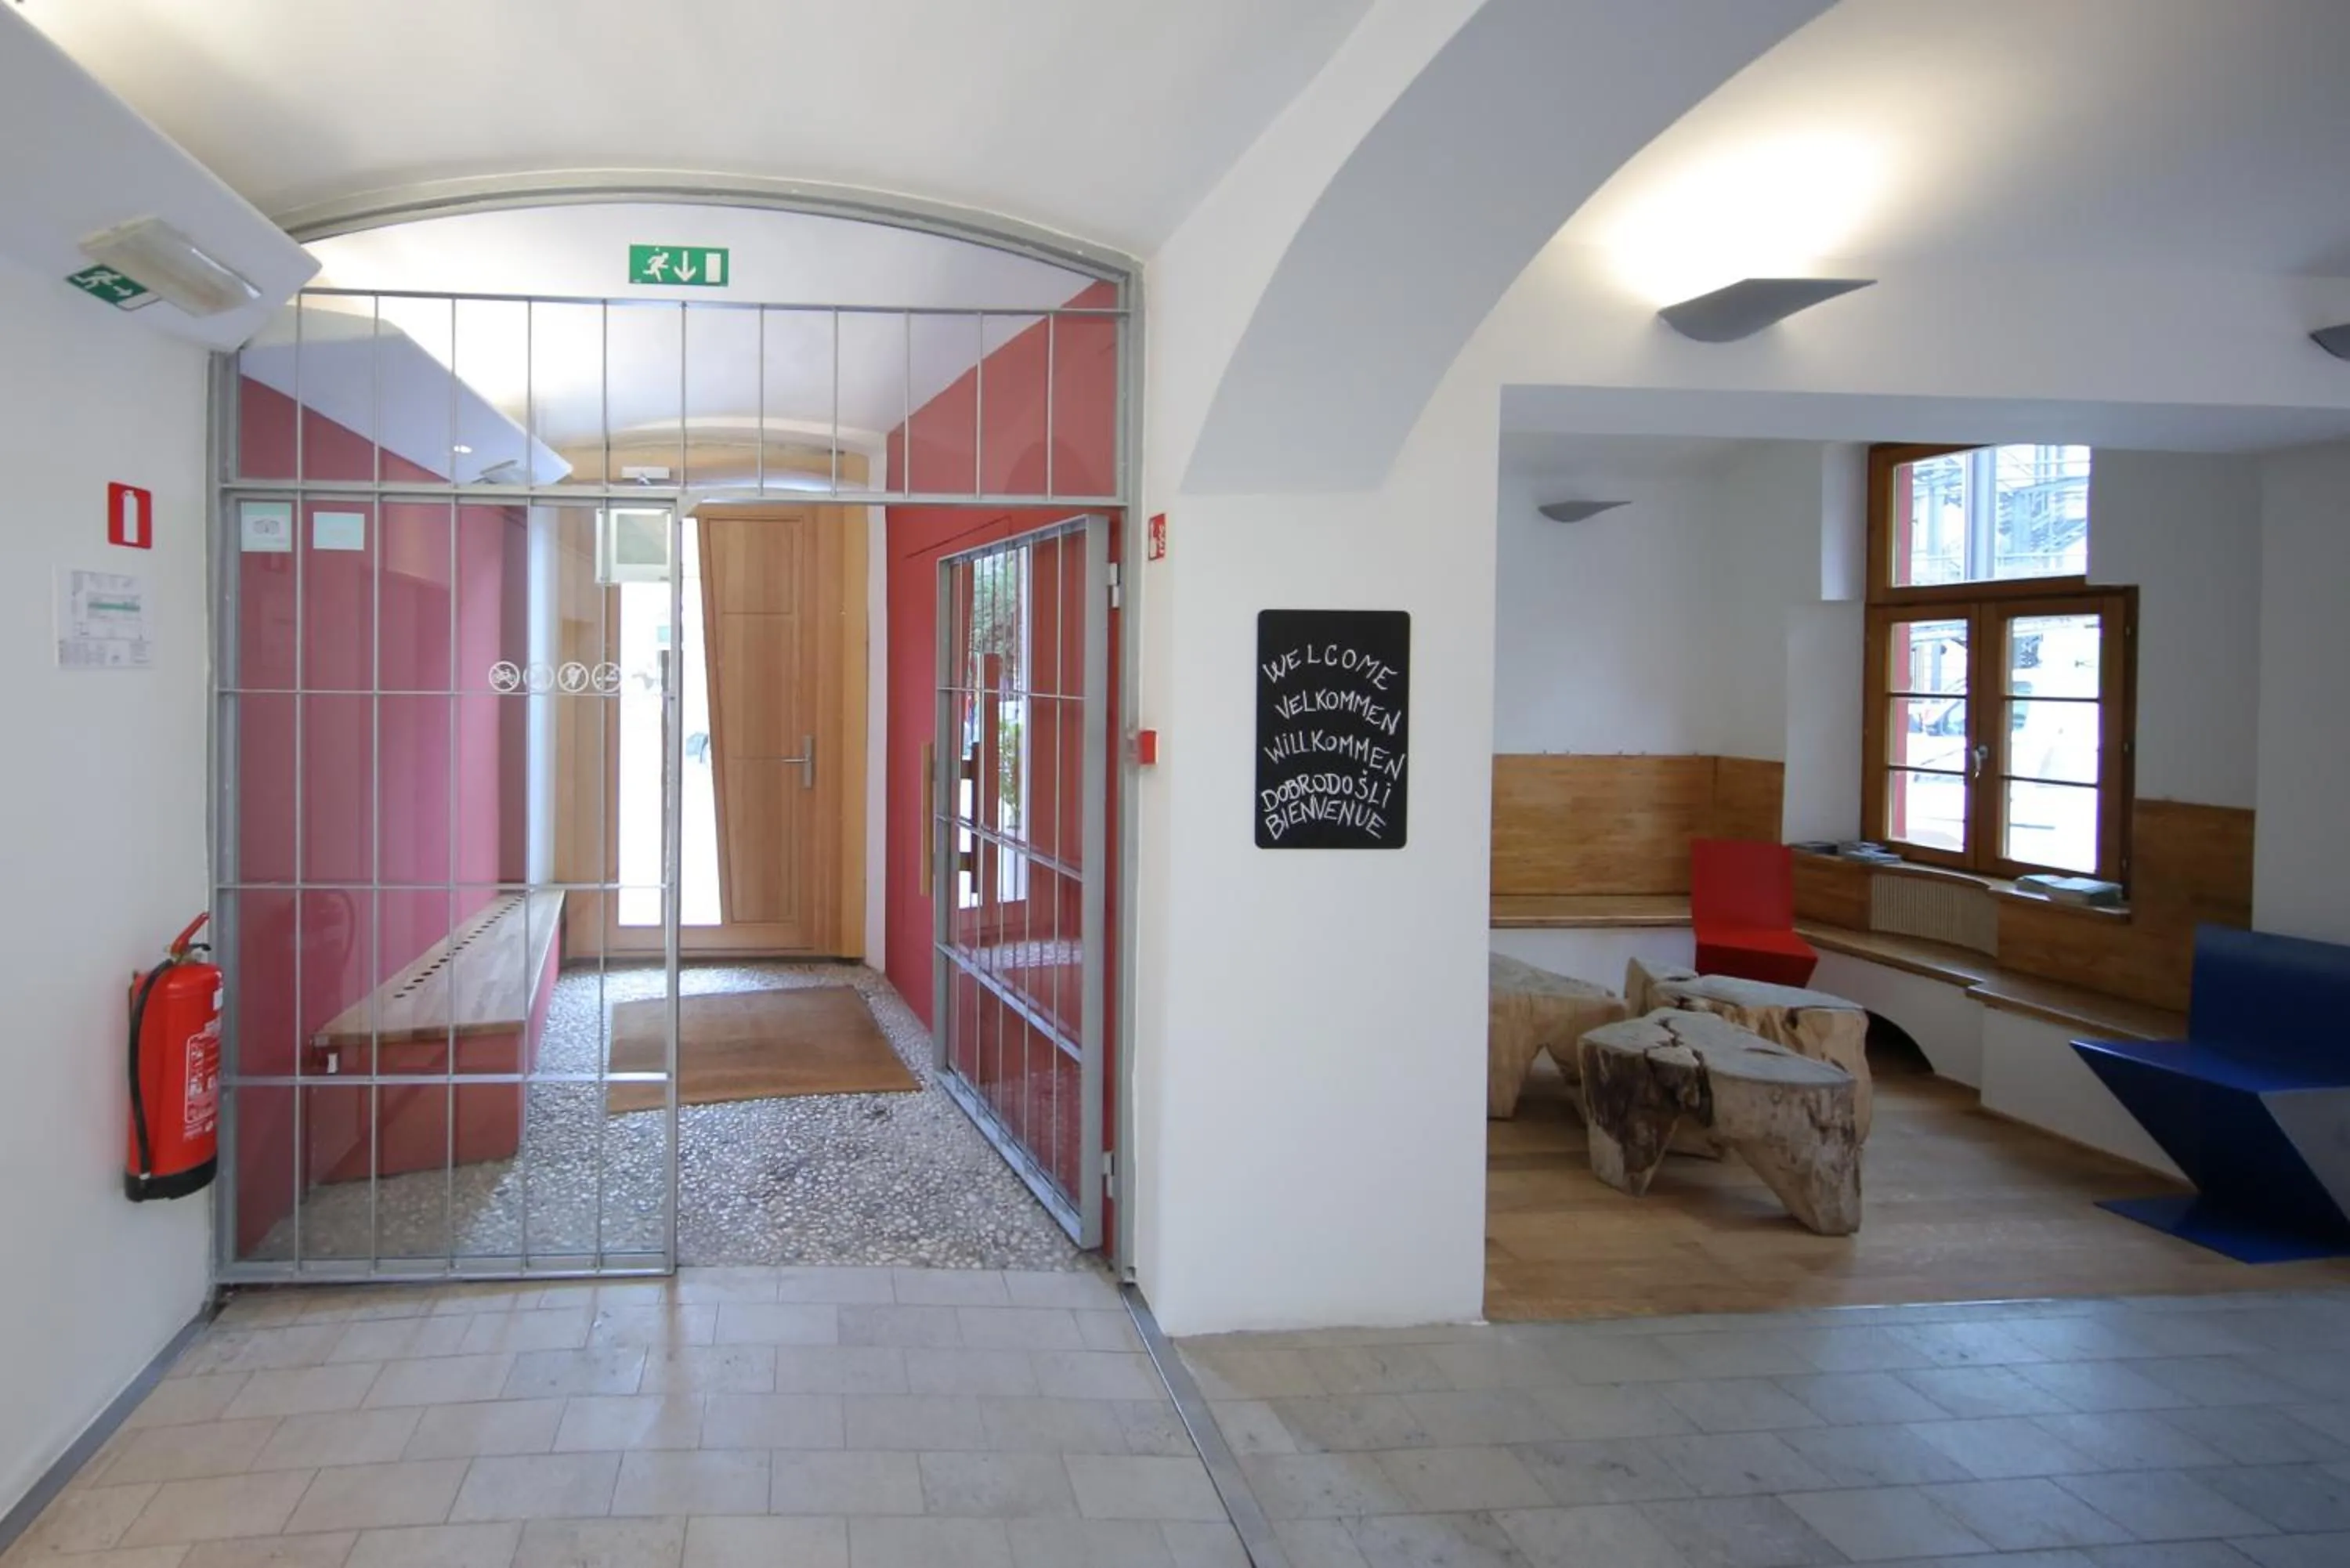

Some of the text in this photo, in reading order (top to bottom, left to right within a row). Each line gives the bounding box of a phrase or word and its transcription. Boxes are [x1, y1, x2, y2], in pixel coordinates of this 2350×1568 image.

[1263, 644, 1398, 690] WELCOME
[1274, 688, 1401, 735] VELKOMMEN
[1264, 793, 1386, 840] BIENVENUE
